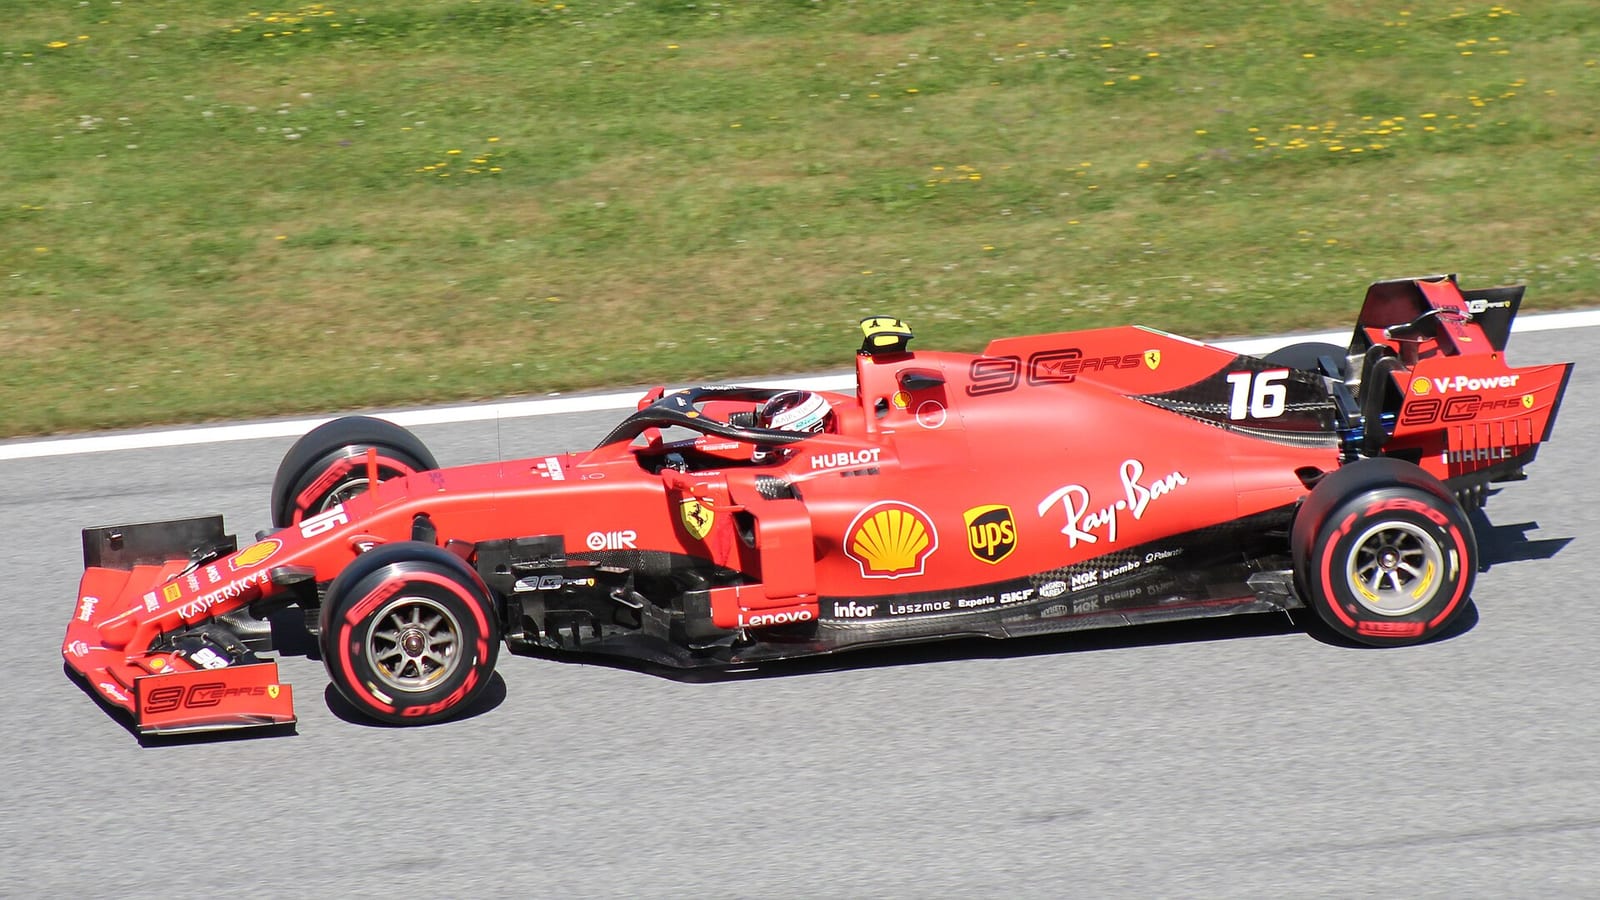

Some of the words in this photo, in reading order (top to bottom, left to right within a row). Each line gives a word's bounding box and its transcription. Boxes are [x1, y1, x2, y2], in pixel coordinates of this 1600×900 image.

[965, 347, 1082, 397] 90
[1041, 353, 1143, 375] YEARS
[1226, 368, 1289, 420] 16
[1434, 374, 1520, 394] V-Power
[1400, 395, 1482, 426] 90
[1454, 398, 1522, 414] YEARS
[811, 448, 880, 469] HUBLOT
[299, 503, 349, 539] 16
[970, 520, 1014, 556] ups
[1071, 570, 1098, 587] NGK
[1102, 560, 1141, 580] brembo
[177, 572, 259, 619] KASPERSKY
[958, 594, 996, 608] Experis
[1000, 588, 1035, 604] SKF
[834, 601, 876, 618] infor
[890, 600, 951, 616] Laszmoe
[738, 610, 812, 629] Lenovo
[144, 682, 226, 714] 90
[199, 686, 267, 699] YEARS
